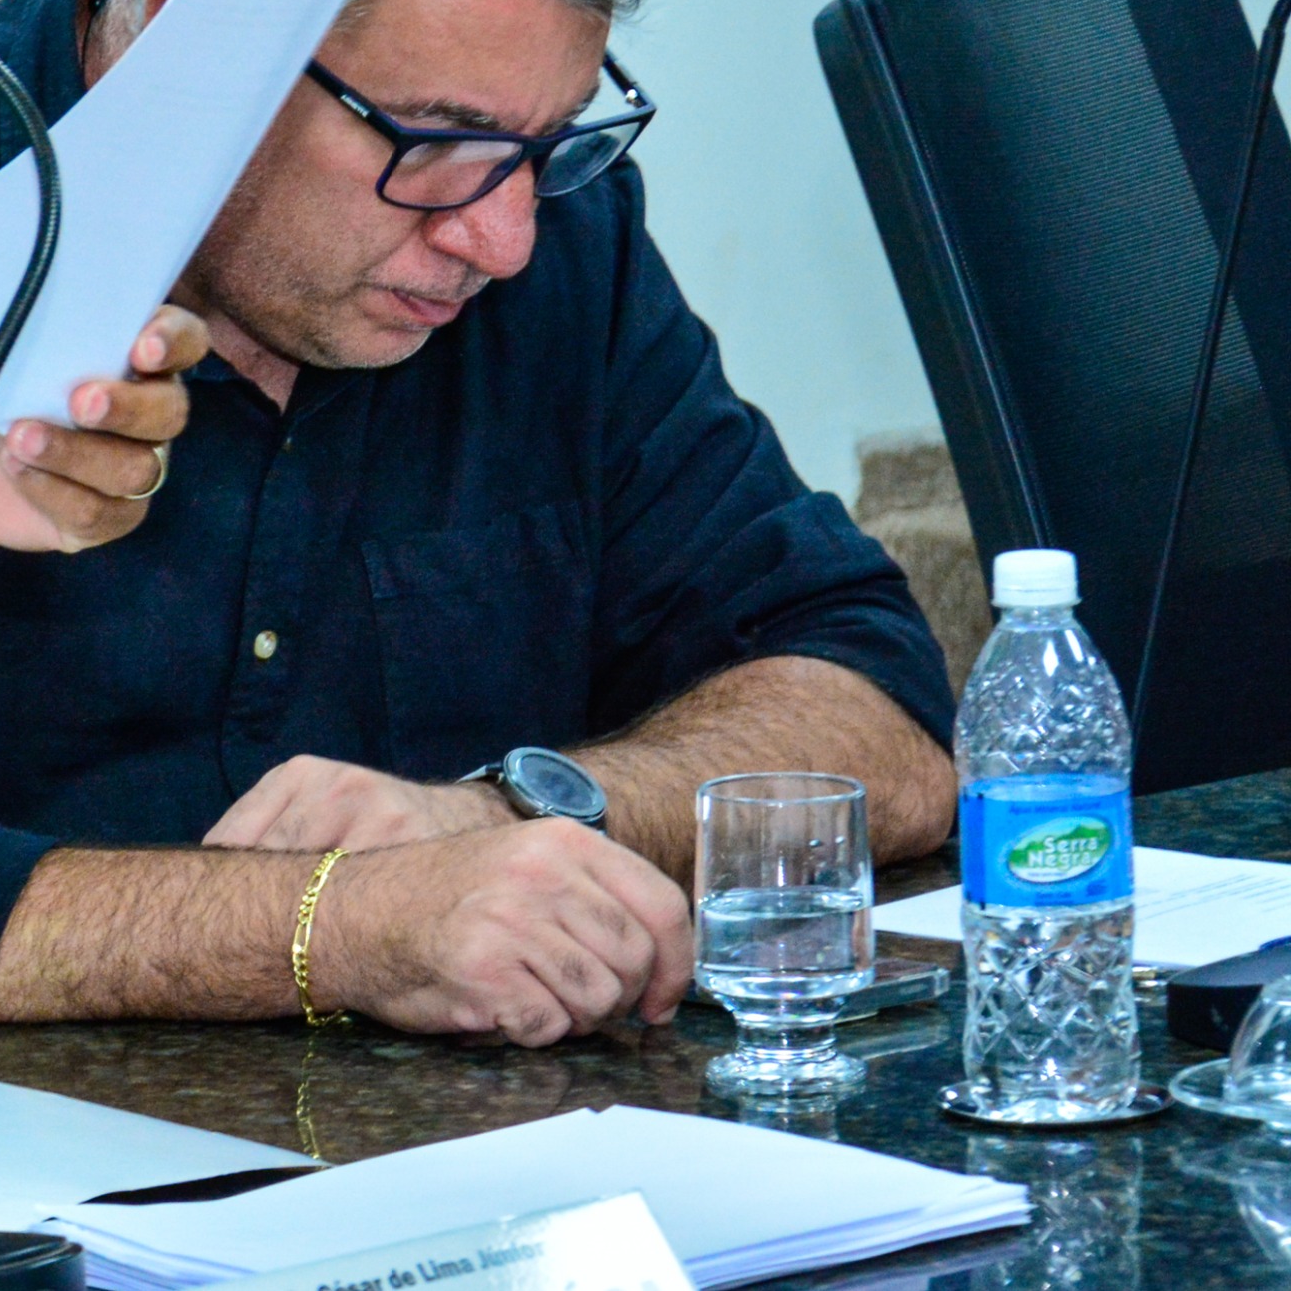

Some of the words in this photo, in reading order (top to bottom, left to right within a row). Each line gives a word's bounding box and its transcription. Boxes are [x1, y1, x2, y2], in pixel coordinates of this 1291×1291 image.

[1042, 836, 1099, 854] Serra
[1028, 851, 1092, 871] Negra
[388, 1267, 417, 1289] de
[416, 1257, 476, 1284] Lima
